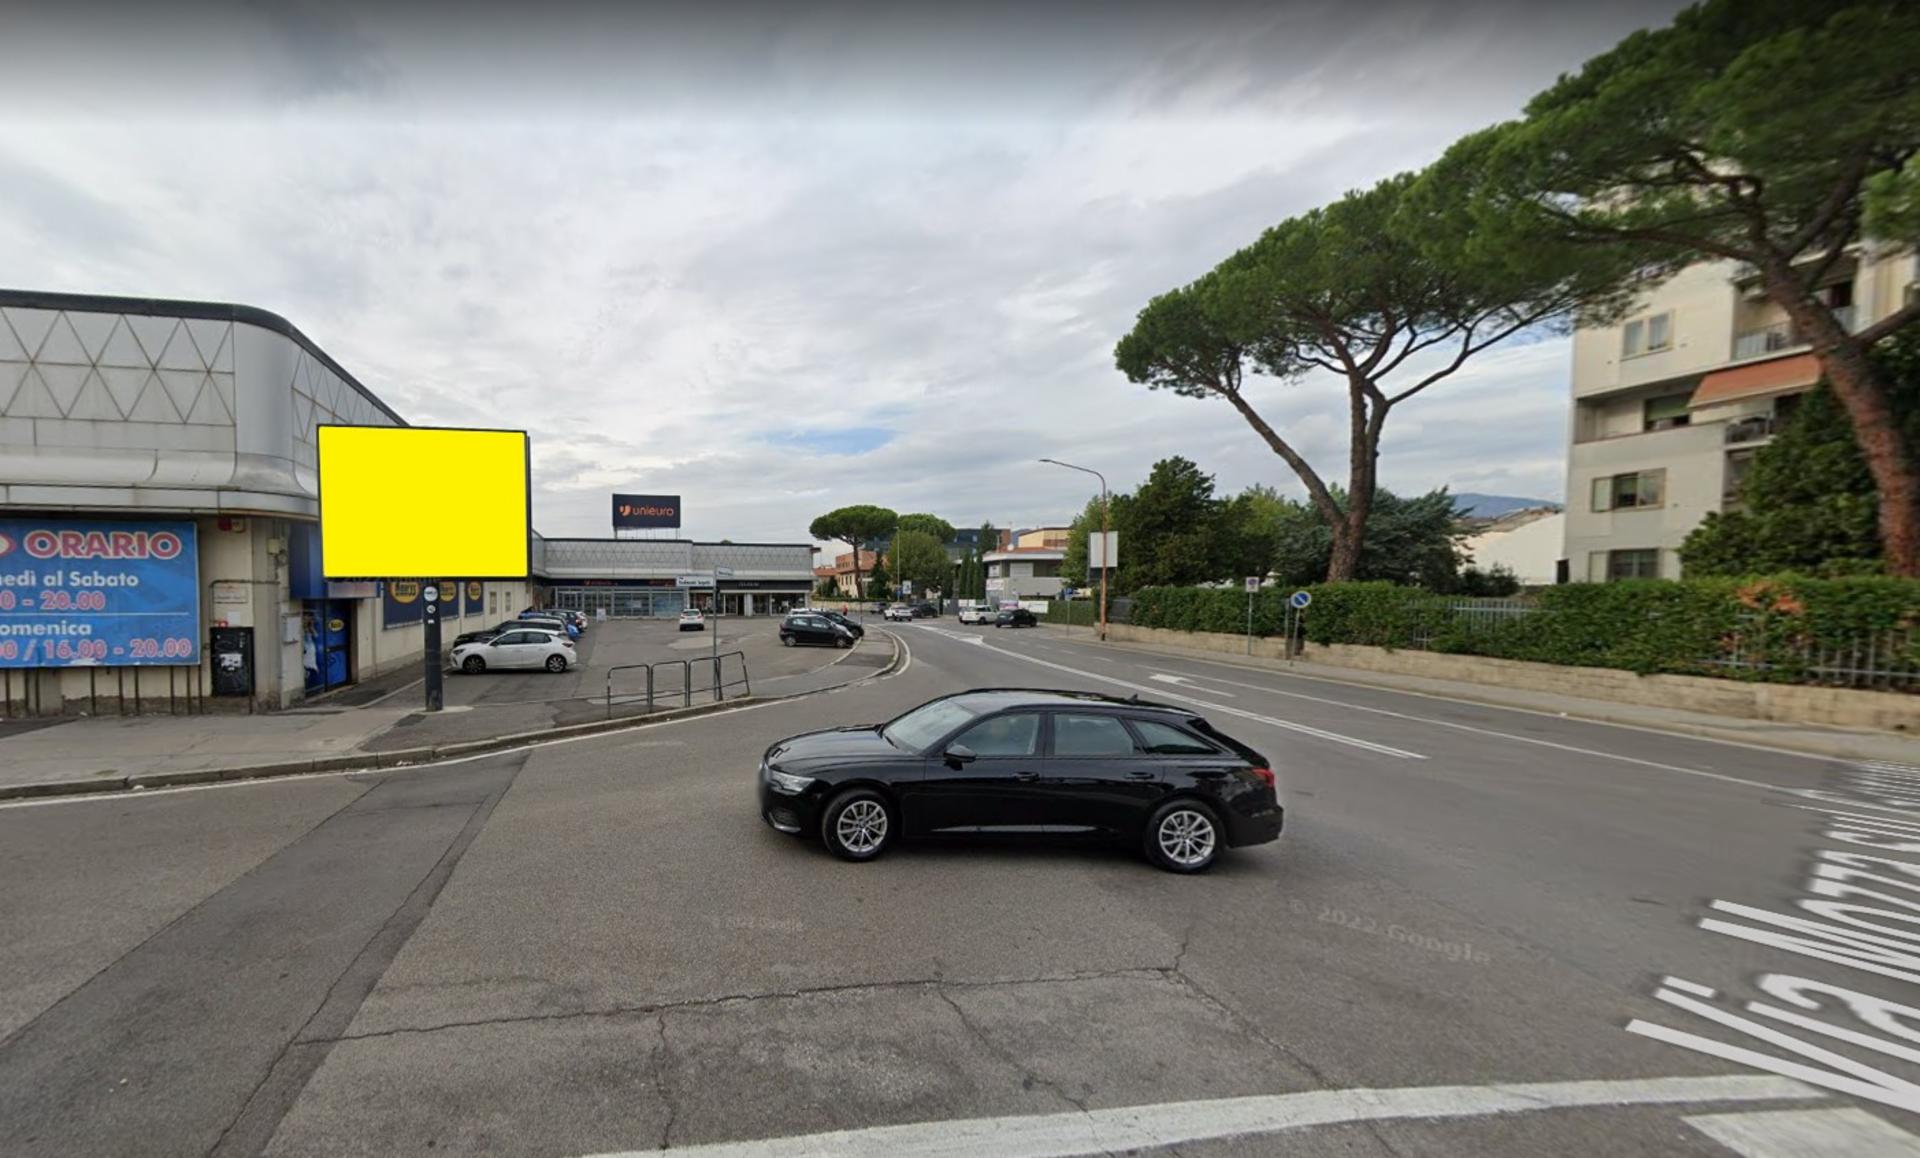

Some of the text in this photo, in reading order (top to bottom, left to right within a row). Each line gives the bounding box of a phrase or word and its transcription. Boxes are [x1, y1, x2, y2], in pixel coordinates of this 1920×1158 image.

[632, 505, 674, 517] unieuro
[23, 529, 182, 560] ORARIO
[43, 570, 63, 587] al
[69, 570, 139, 587] Sabato
[40, 590, 106, 611] 20.00
[23, 638, 37, 661] /
[43, 638, 108, 660] 16.00
[129, 637, 192, 659] 20.00
